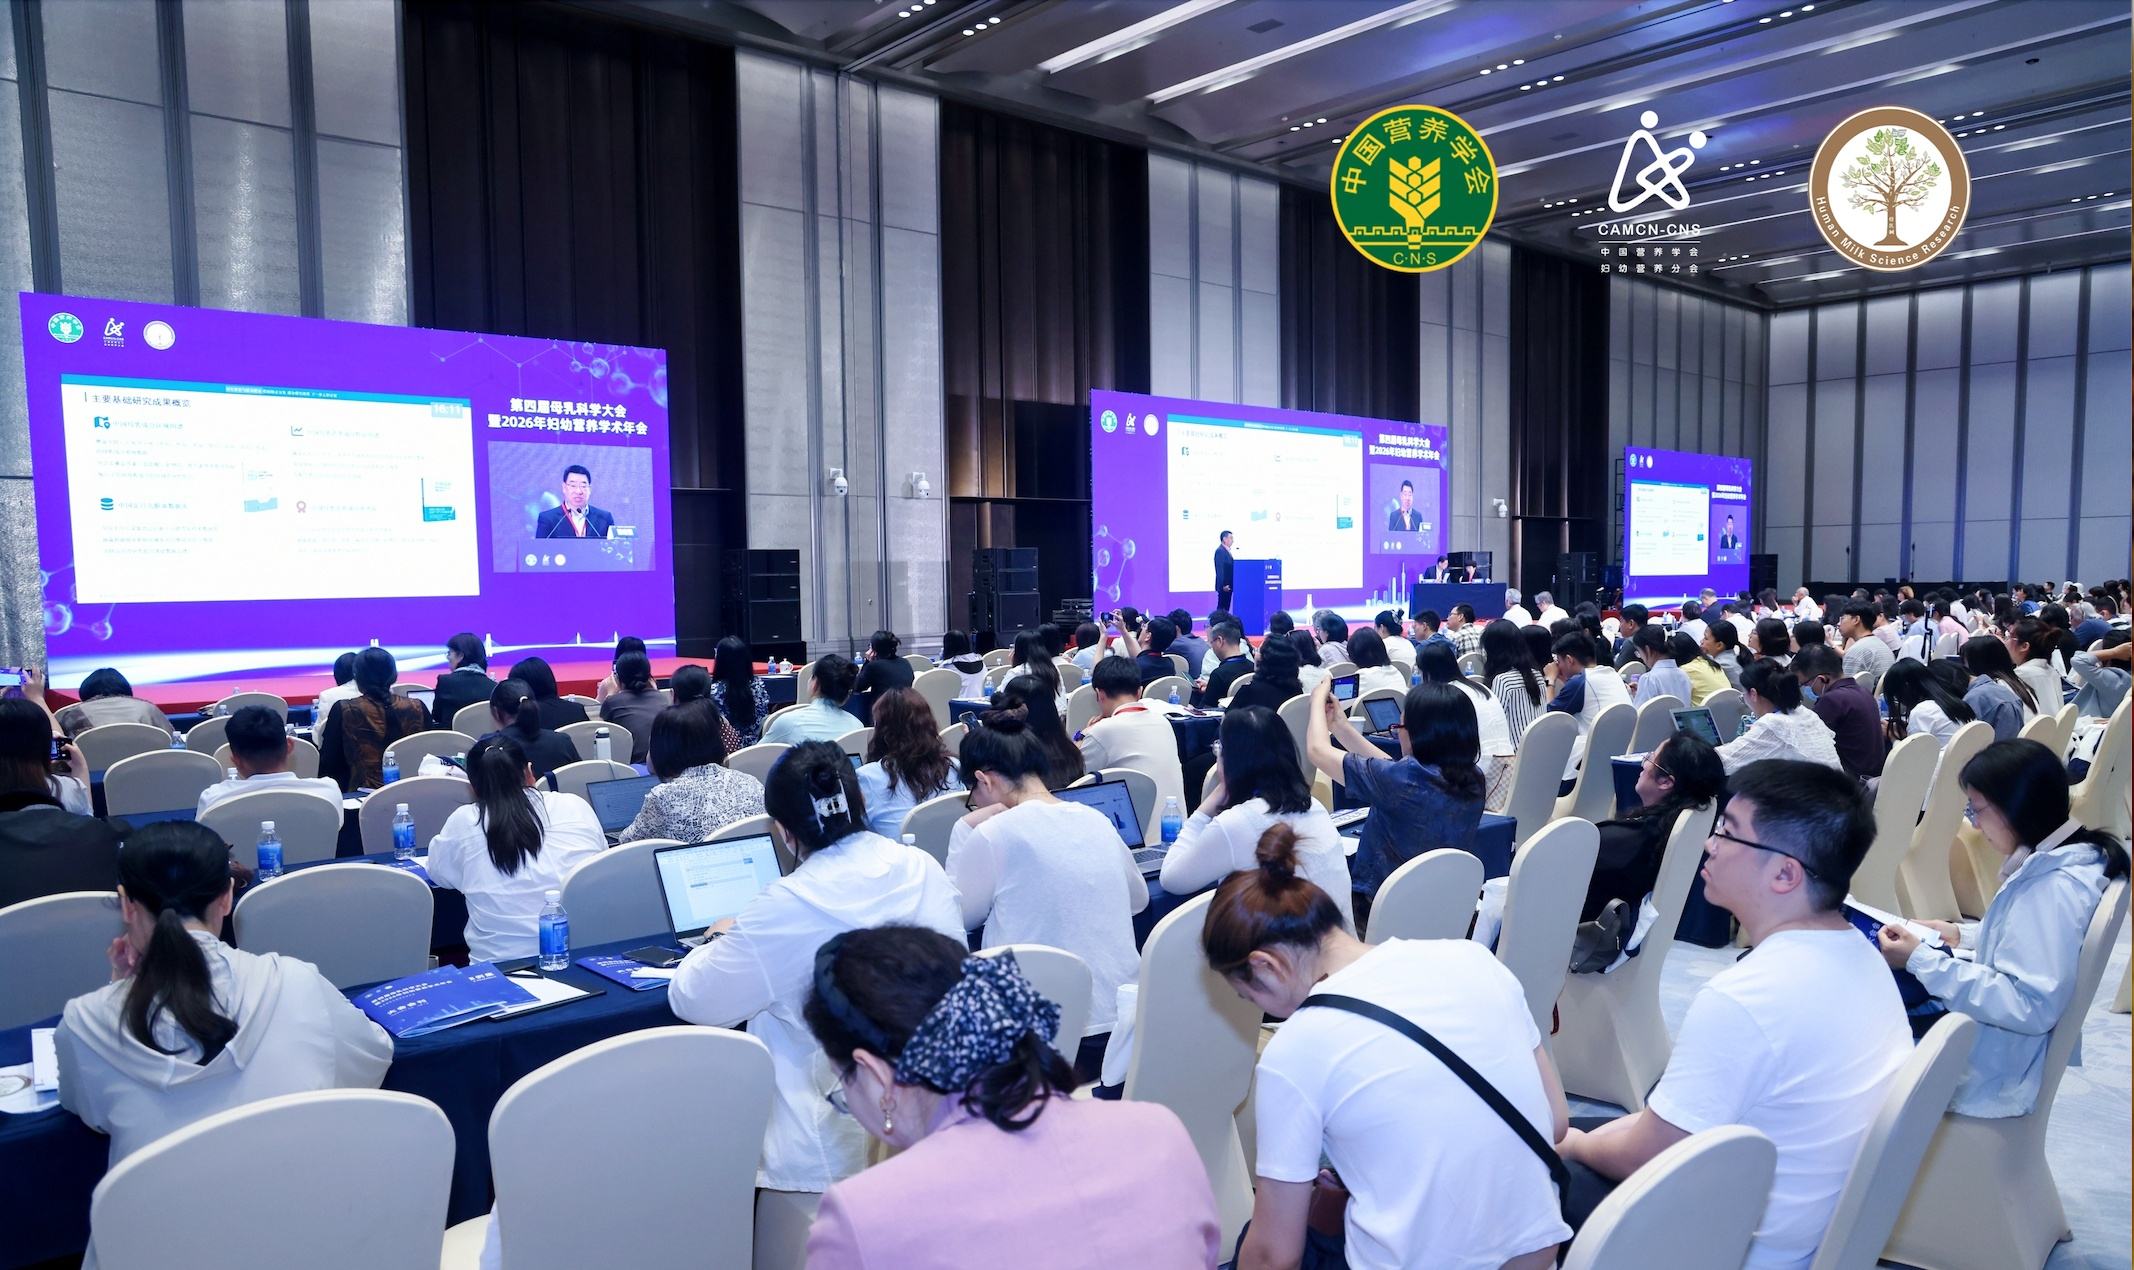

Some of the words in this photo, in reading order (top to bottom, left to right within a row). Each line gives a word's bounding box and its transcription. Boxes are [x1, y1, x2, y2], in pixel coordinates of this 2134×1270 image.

[509, 397, 627, 419] 第四届母乳科学大会
[487, 413, 649, 436] 暨2026年妇幼营养学术年会
